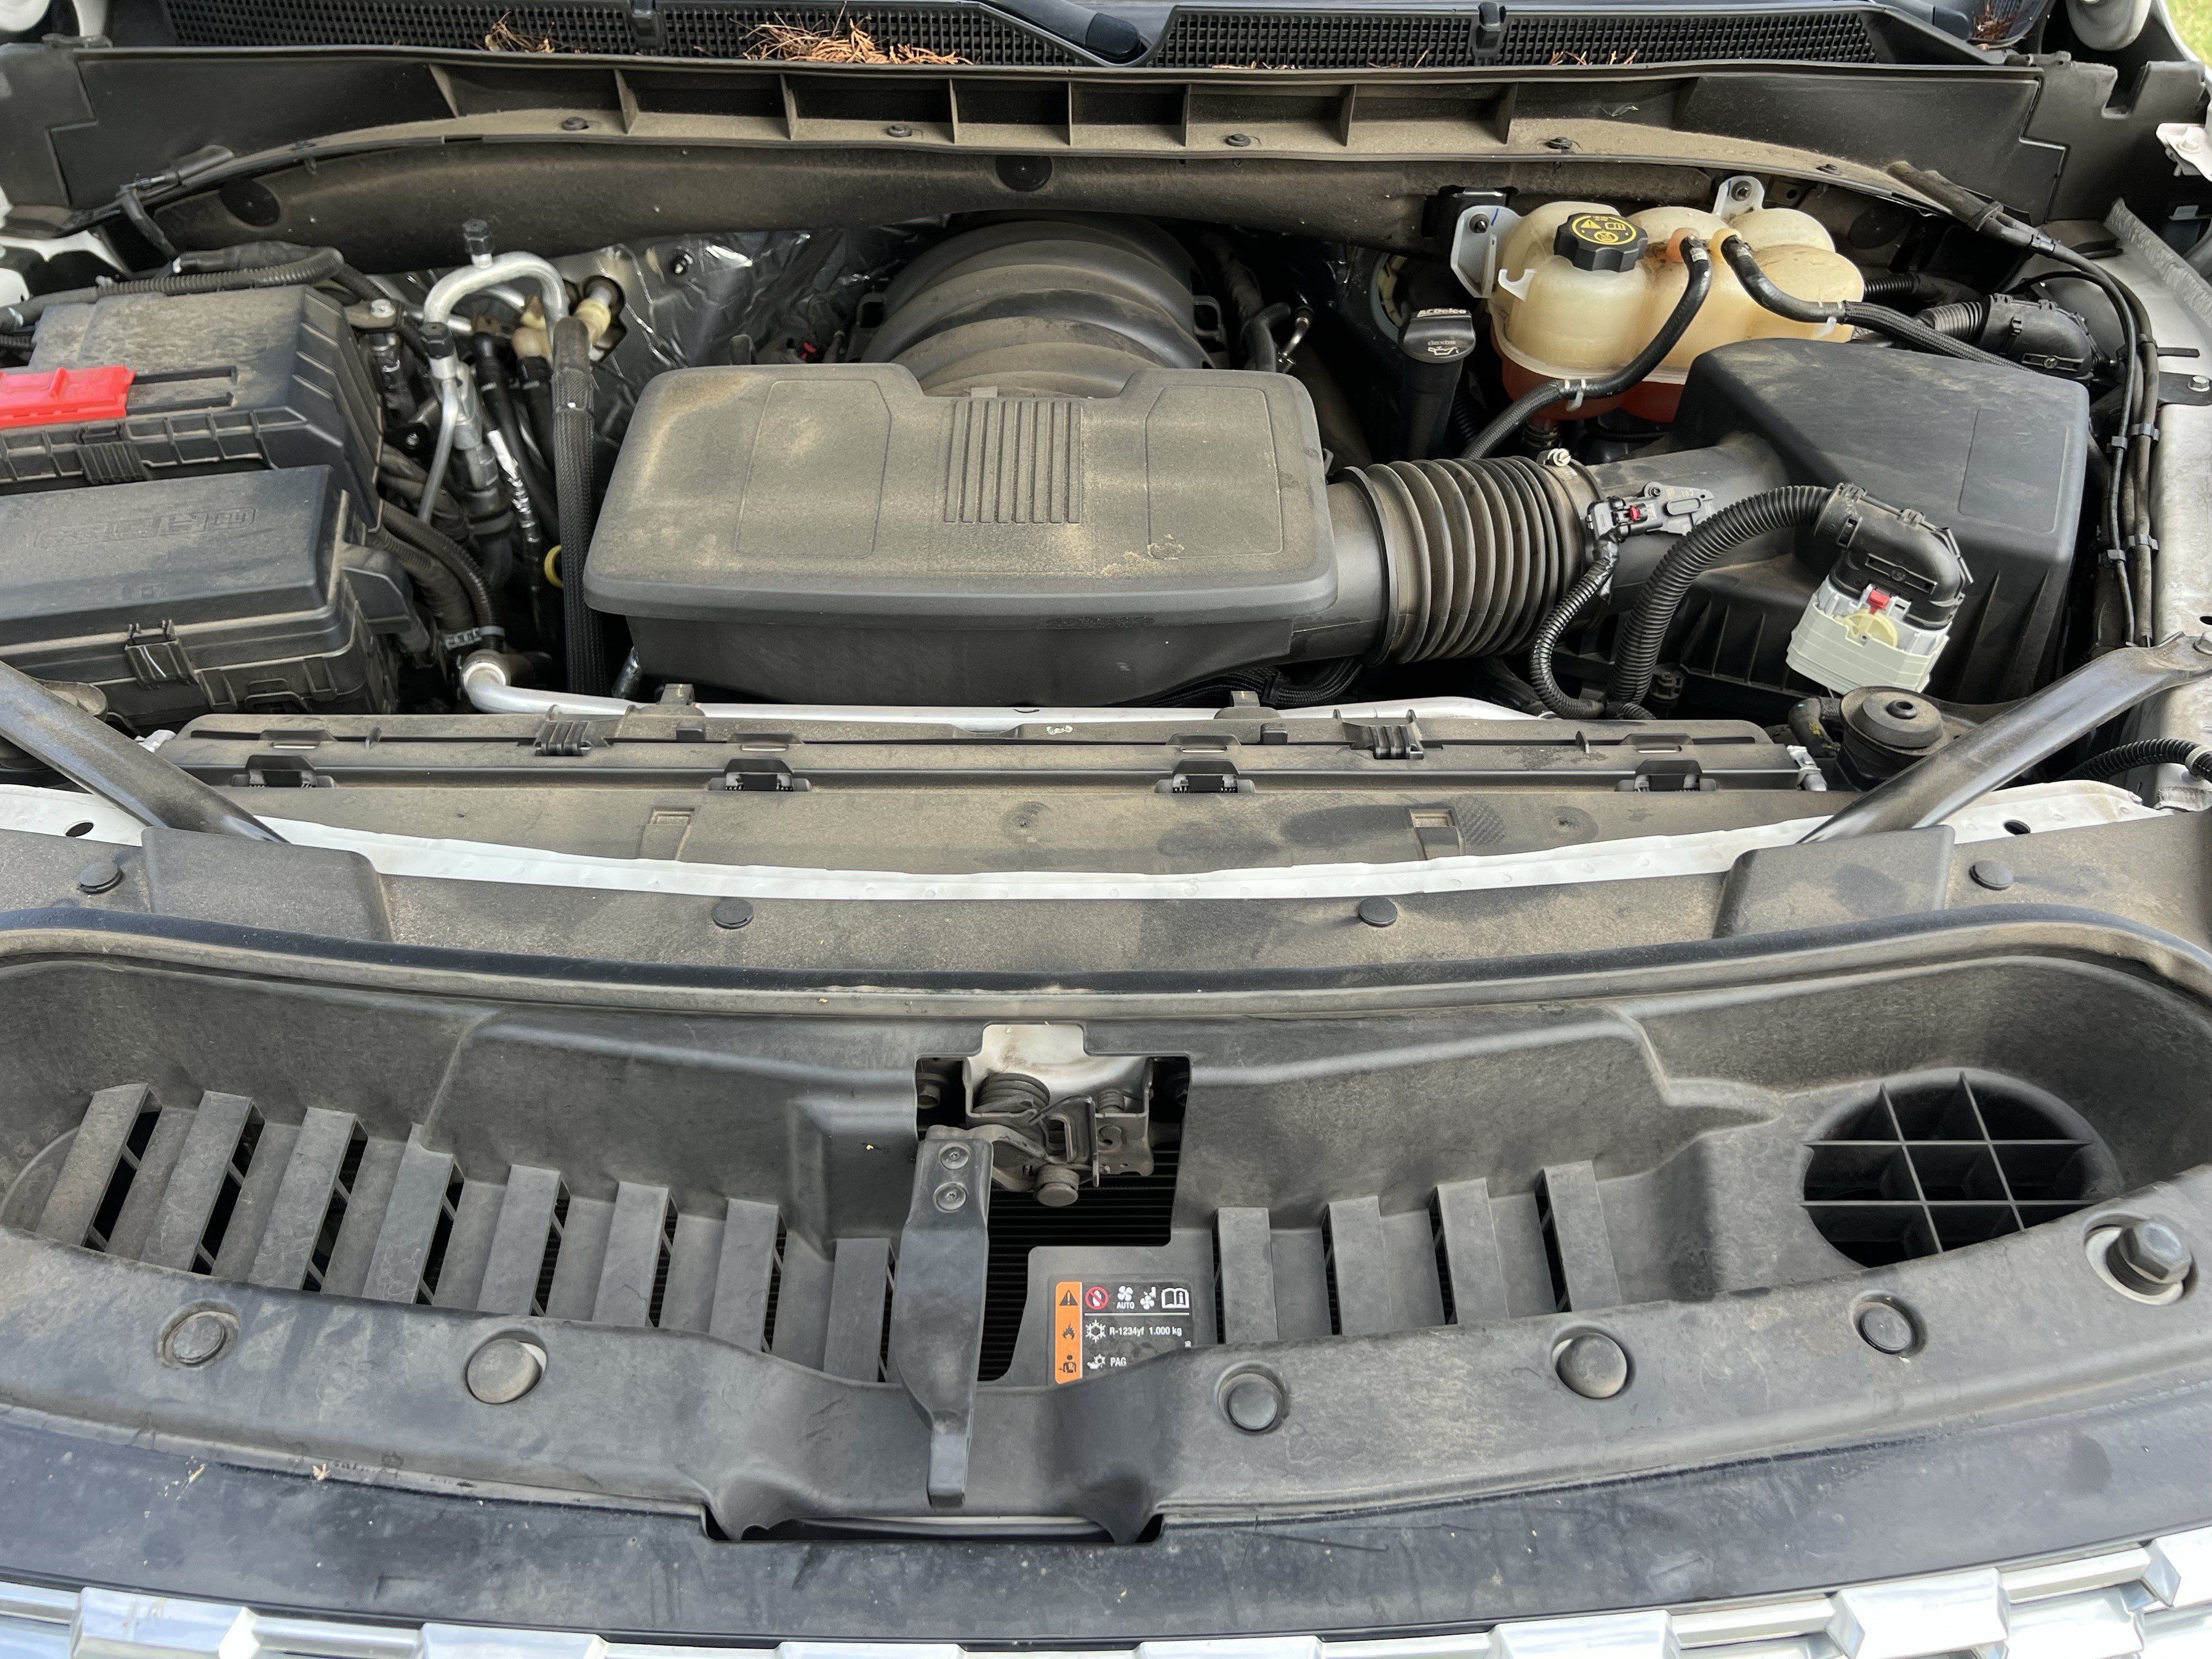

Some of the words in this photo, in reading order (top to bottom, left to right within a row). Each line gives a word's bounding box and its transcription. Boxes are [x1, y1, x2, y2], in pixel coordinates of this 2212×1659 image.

[1417, 308, 1466, 317] ACDelco
[1109, 1326, 1144, 1337] R-1234yf
[1149, 1326, 1170, 1335] 1.000
[1172, 1325, 1182, 1336] kg
[1110, 1357, 1126, 1367] PAG
